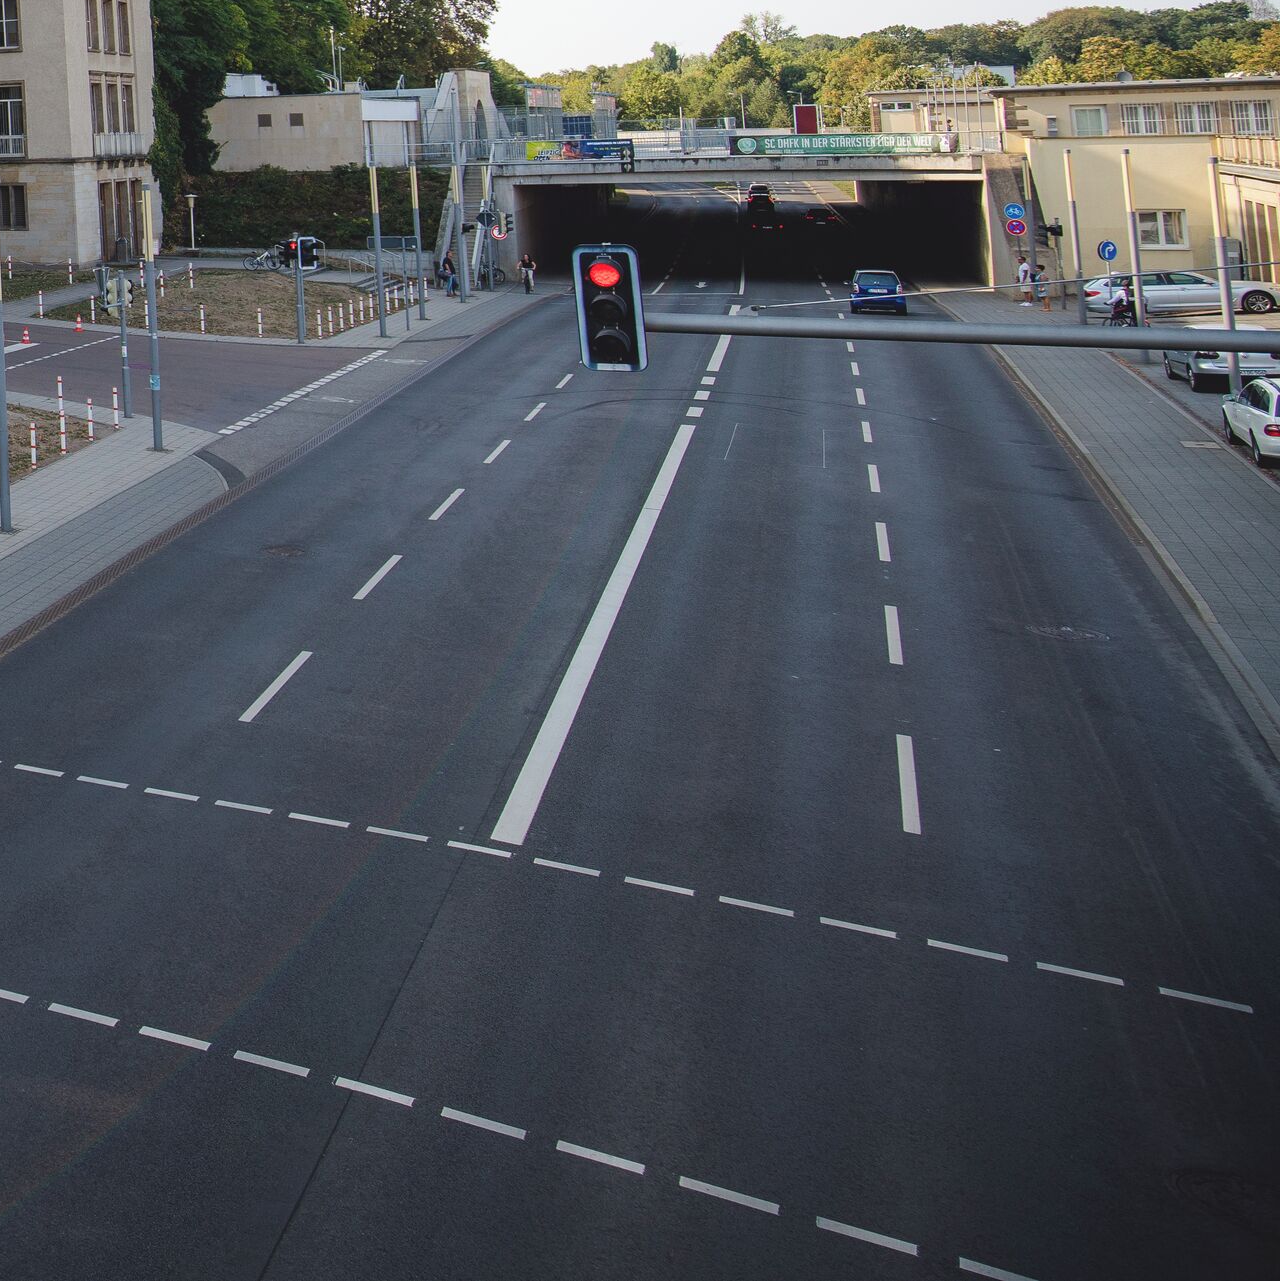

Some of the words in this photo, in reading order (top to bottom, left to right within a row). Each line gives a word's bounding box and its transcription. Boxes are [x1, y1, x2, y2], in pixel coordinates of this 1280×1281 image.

[764, 138, 776, 149] SC
[801, 138, 811, 148] IN
[812, 137, 828, 148] DER
[829, 136, 876, 148] STÄRKSTEN
[896, 136, 912, 147] DER
[913, 135, 933, 147] WELT
